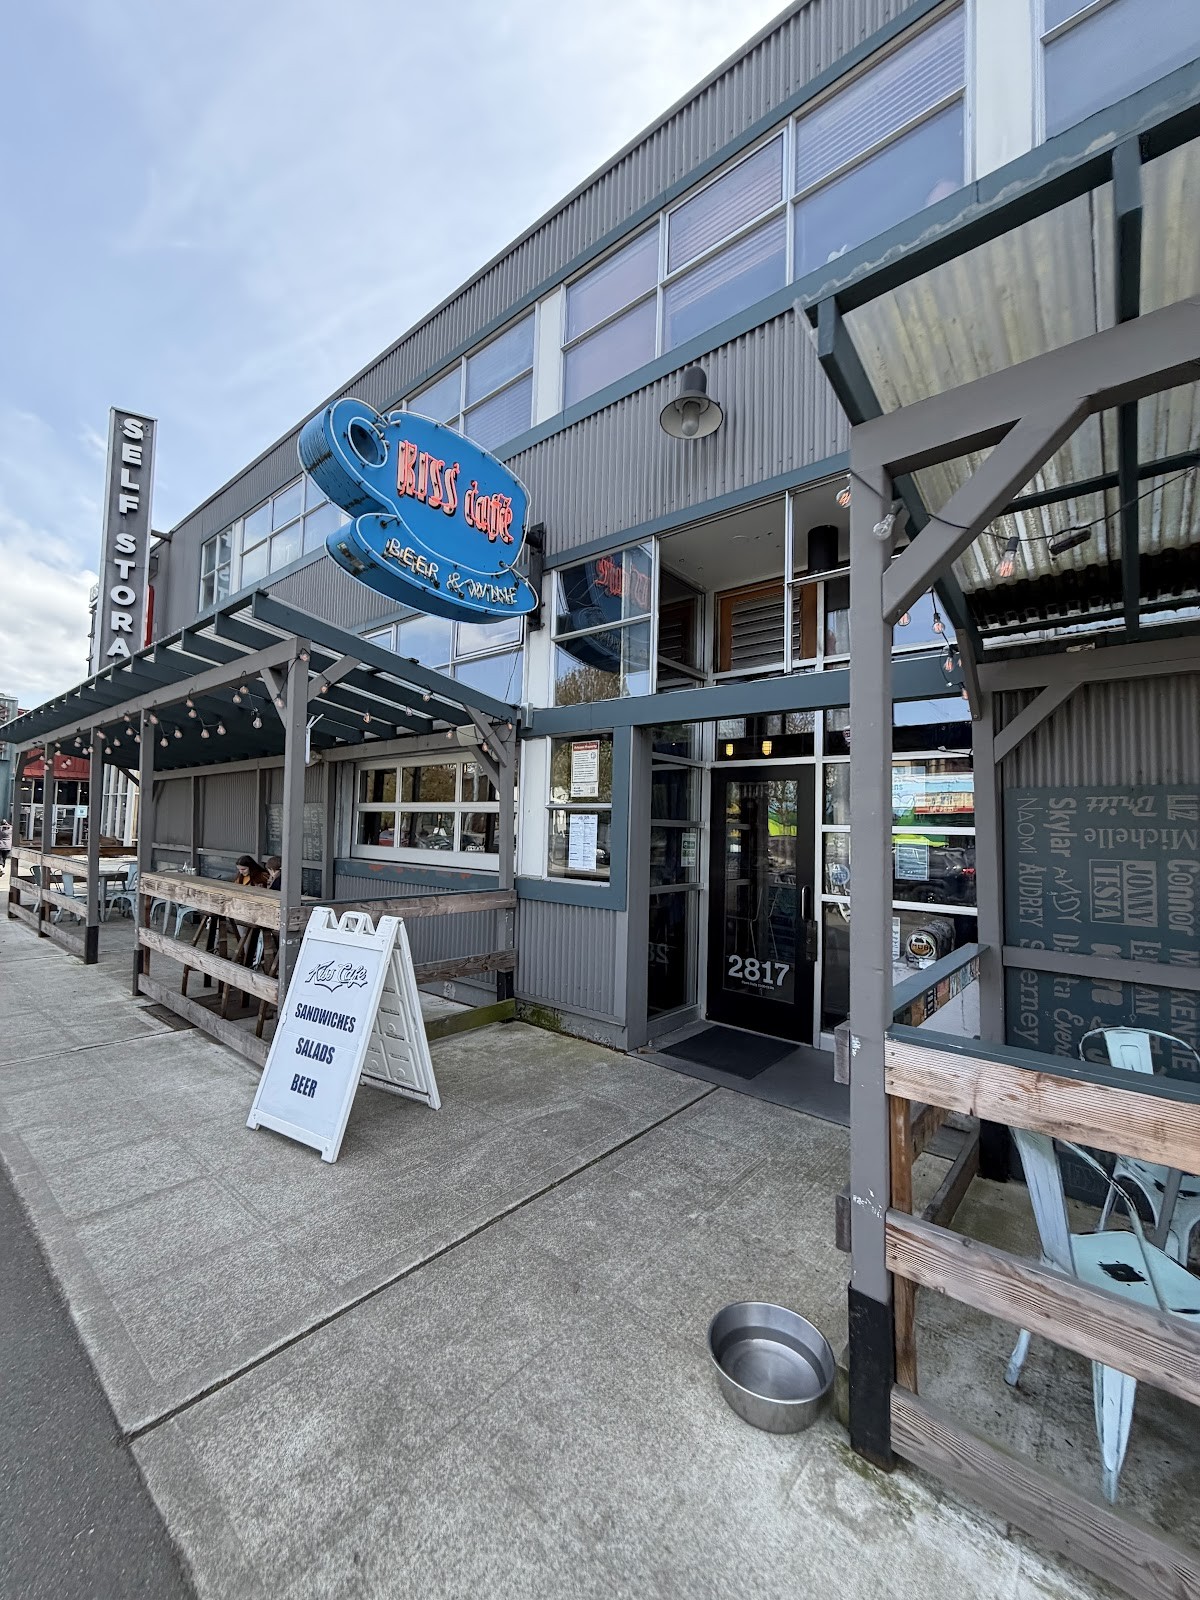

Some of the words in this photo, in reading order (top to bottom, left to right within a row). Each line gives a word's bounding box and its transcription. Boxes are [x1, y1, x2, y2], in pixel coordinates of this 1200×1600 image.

[119, 418, 144, 514] SELF
[397, 440, 460, 514] KISS
[384, 538, 439, 580] BEER
[446, 572, 462, 595] &
[467, 580, 518, 605] WINE
[1043, 797, 1077, 858] Skylar
[1084, 828, 1200, 850] Michelle
[1092, 865, 1122, 918] TESTA
[1126, 863, 1155, 924] JONNY
[1167, 859, 1200, 937] Connor
[728, 954, 790, 987] 2817
[294, 1002, 356, 1033] SANDWICHES
[295, 1037, 335, 1064] SALADS
[290, 1073, 318, 1099] BEER
